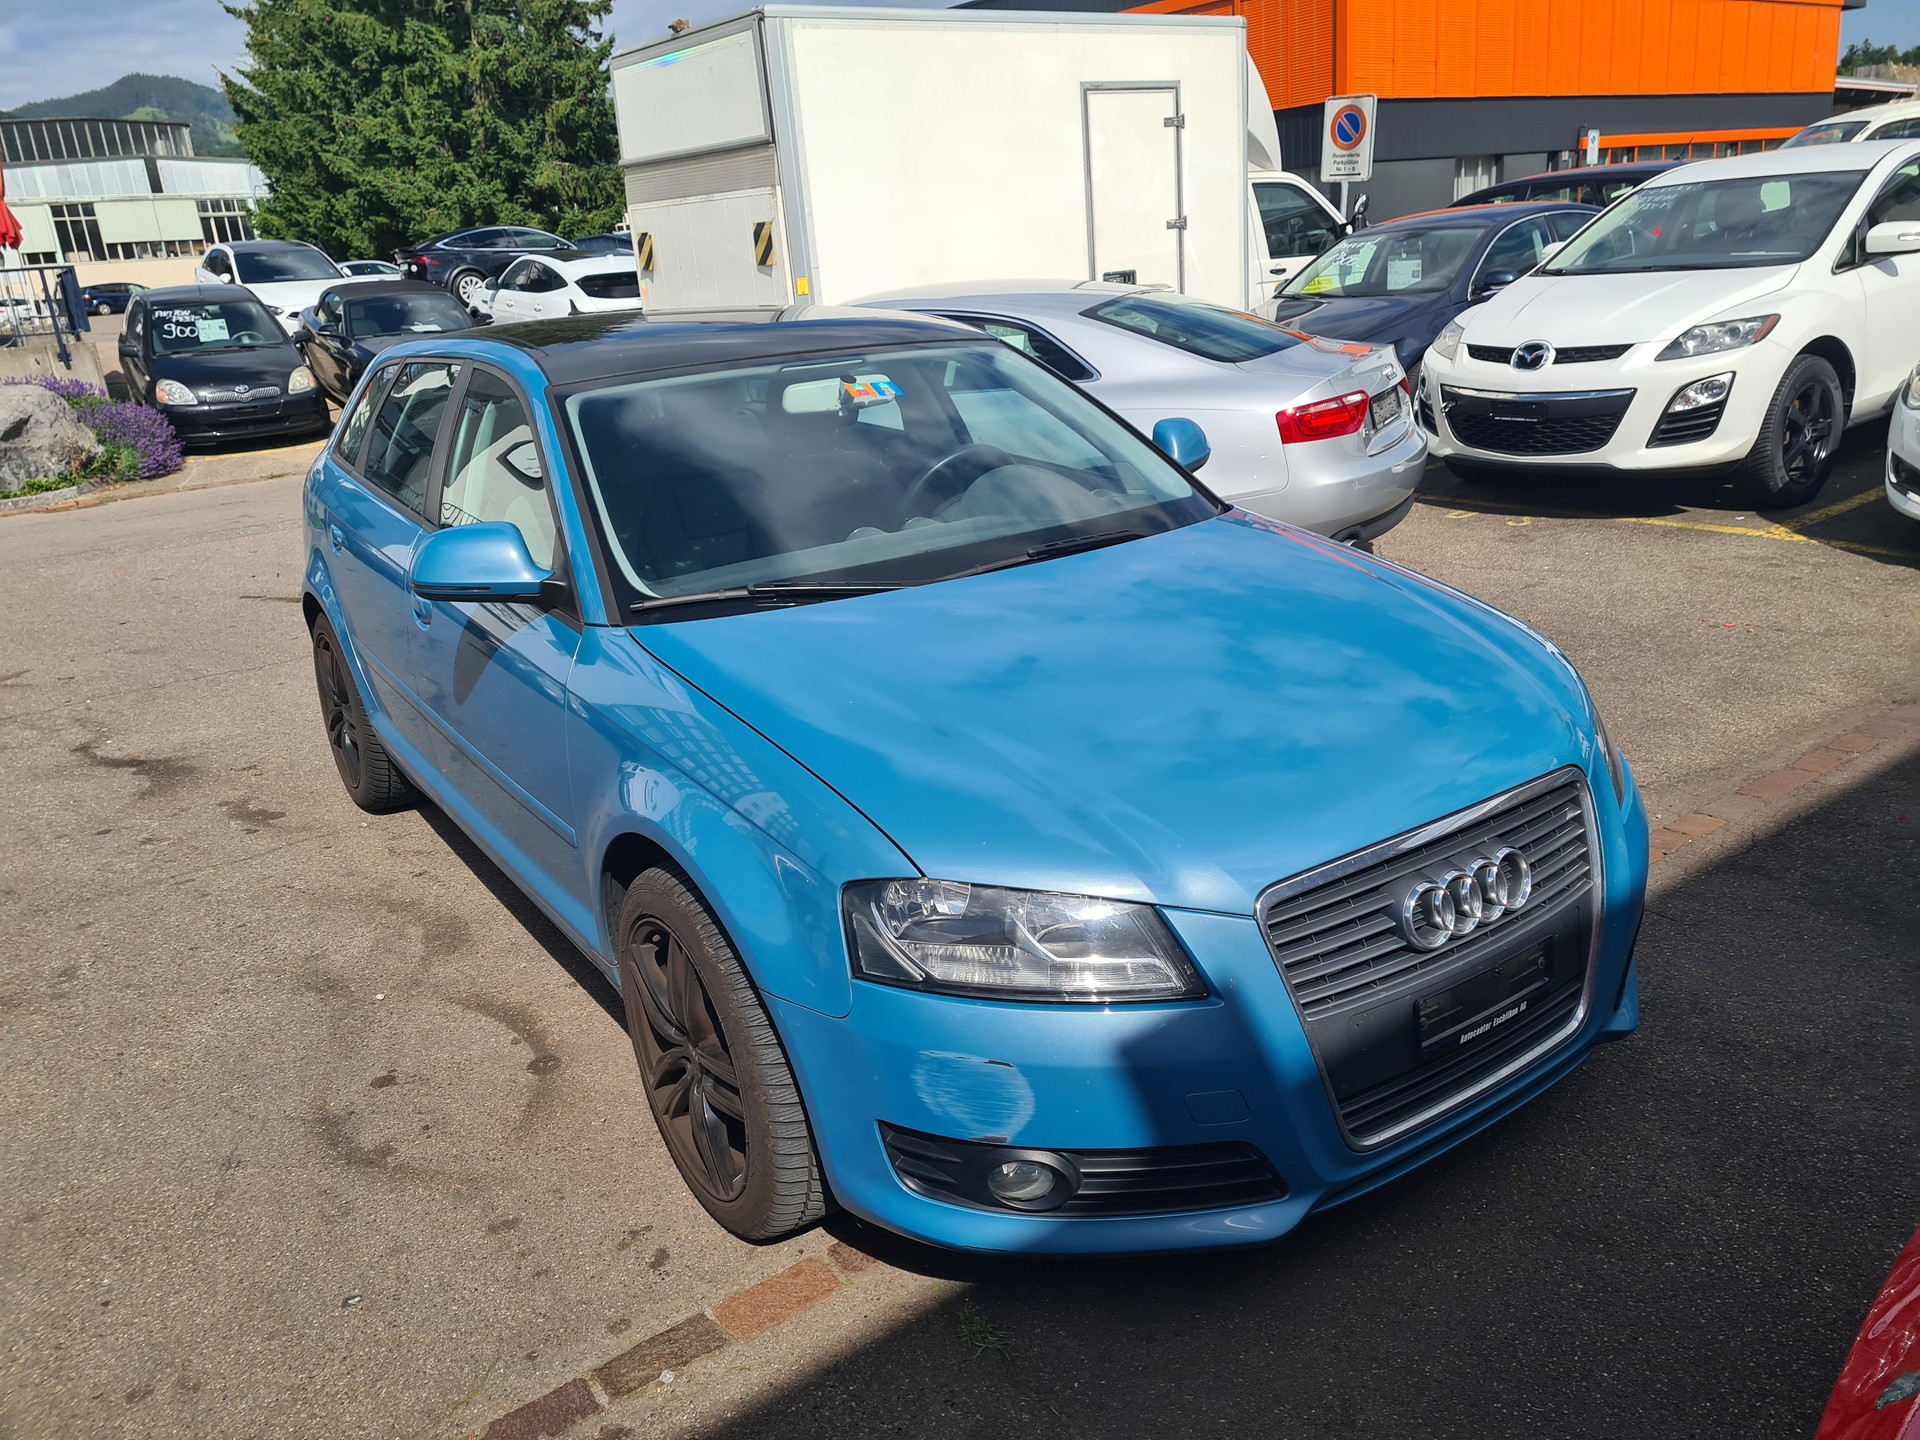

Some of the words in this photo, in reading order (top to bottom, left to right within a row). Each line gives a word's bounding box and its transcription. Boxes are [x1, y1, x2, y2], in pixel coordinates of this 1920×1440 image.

[1459, 1021, 1492, 1044] Autocenter
[1493, 1006, 1519, 1027] Eschlikon
[1519, 1001, 1527, 1012] AG
